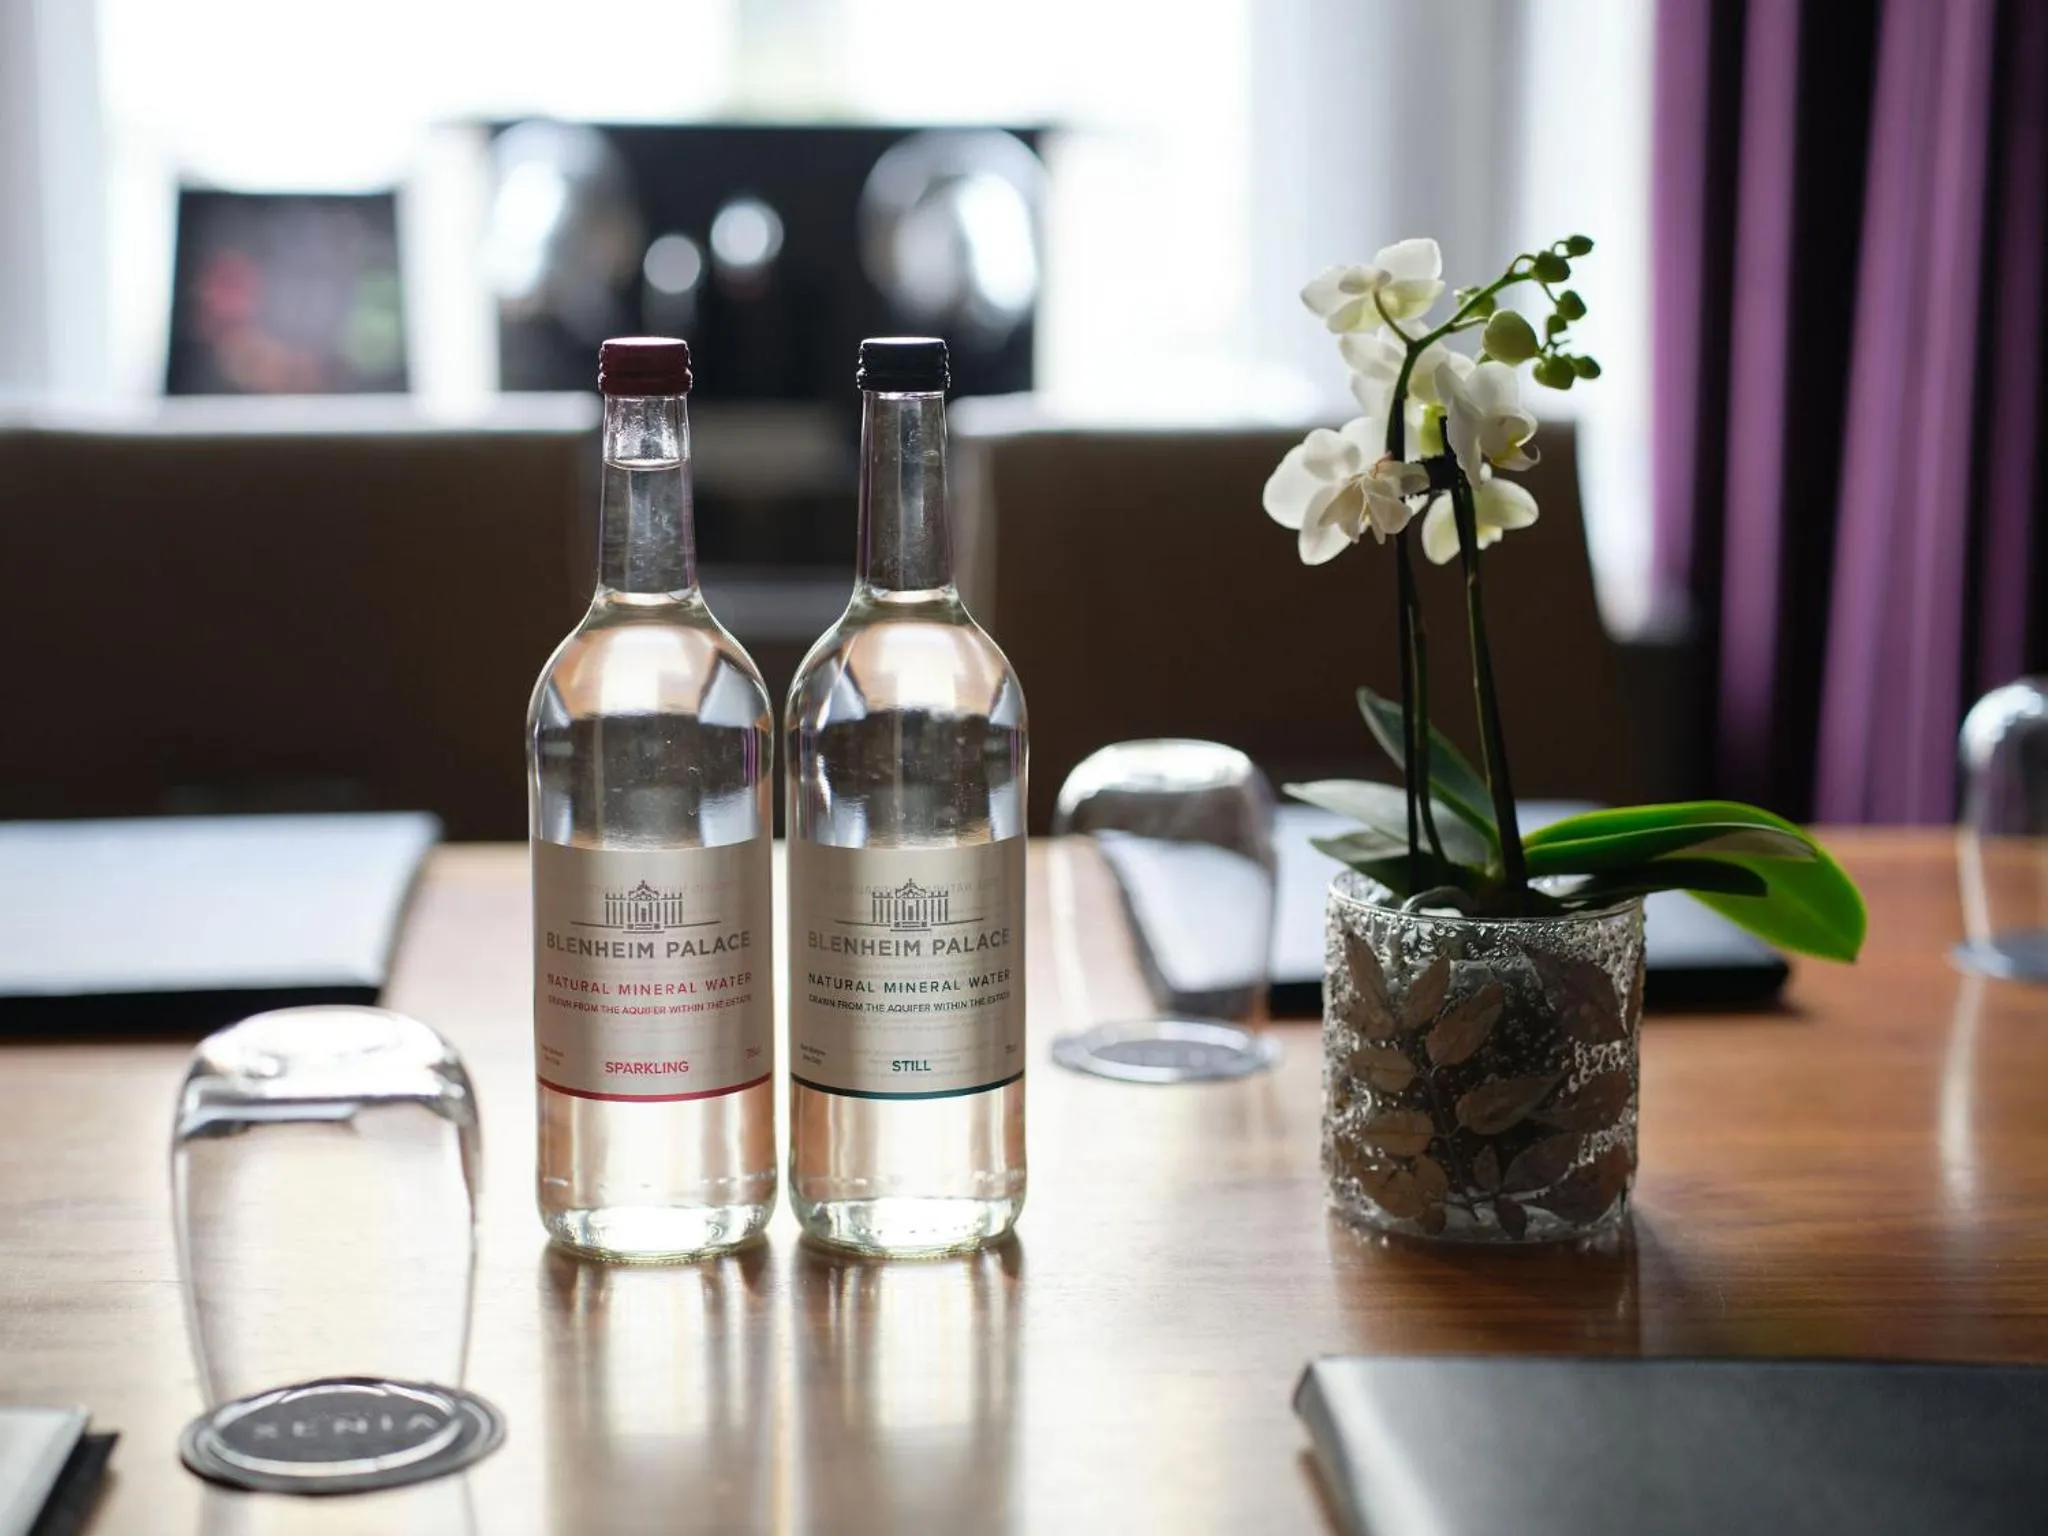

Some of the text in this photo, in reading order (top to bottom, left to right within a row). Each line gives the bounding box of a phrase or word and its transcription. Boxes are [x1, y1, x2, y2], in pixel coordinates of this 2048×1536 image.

[547, 931, 750, 958] BLENHEIM PALACE
[808, 928, 1009, 956] BLENHEIM PALACE
[548, 972, 752, 996] NATURAL MINERAL WATER
[808, 970, 1010, 993] NATURAL MINERAL WATER
[573, 1003, 598, 1012] FROM
[600, 1005, 619, 1014] THE
[622, 1006, 666, 1015] AQUIFER
[669, 1003, 704, 1014] WITHIN
[707, 1001, 725, 1010] THE
[838, 1000, 864, 1011] FROM
[866, 1003, 885, 1012] THE
[888, 1003, 930, 1013] AQUIFER
[934, 1001, 967, 1010] WITHIN
[970, 997, 986, 1008] THE
[605, 1061, 689, 1074] SPARKLING
[892, 1060, 931, 1072] STILL
